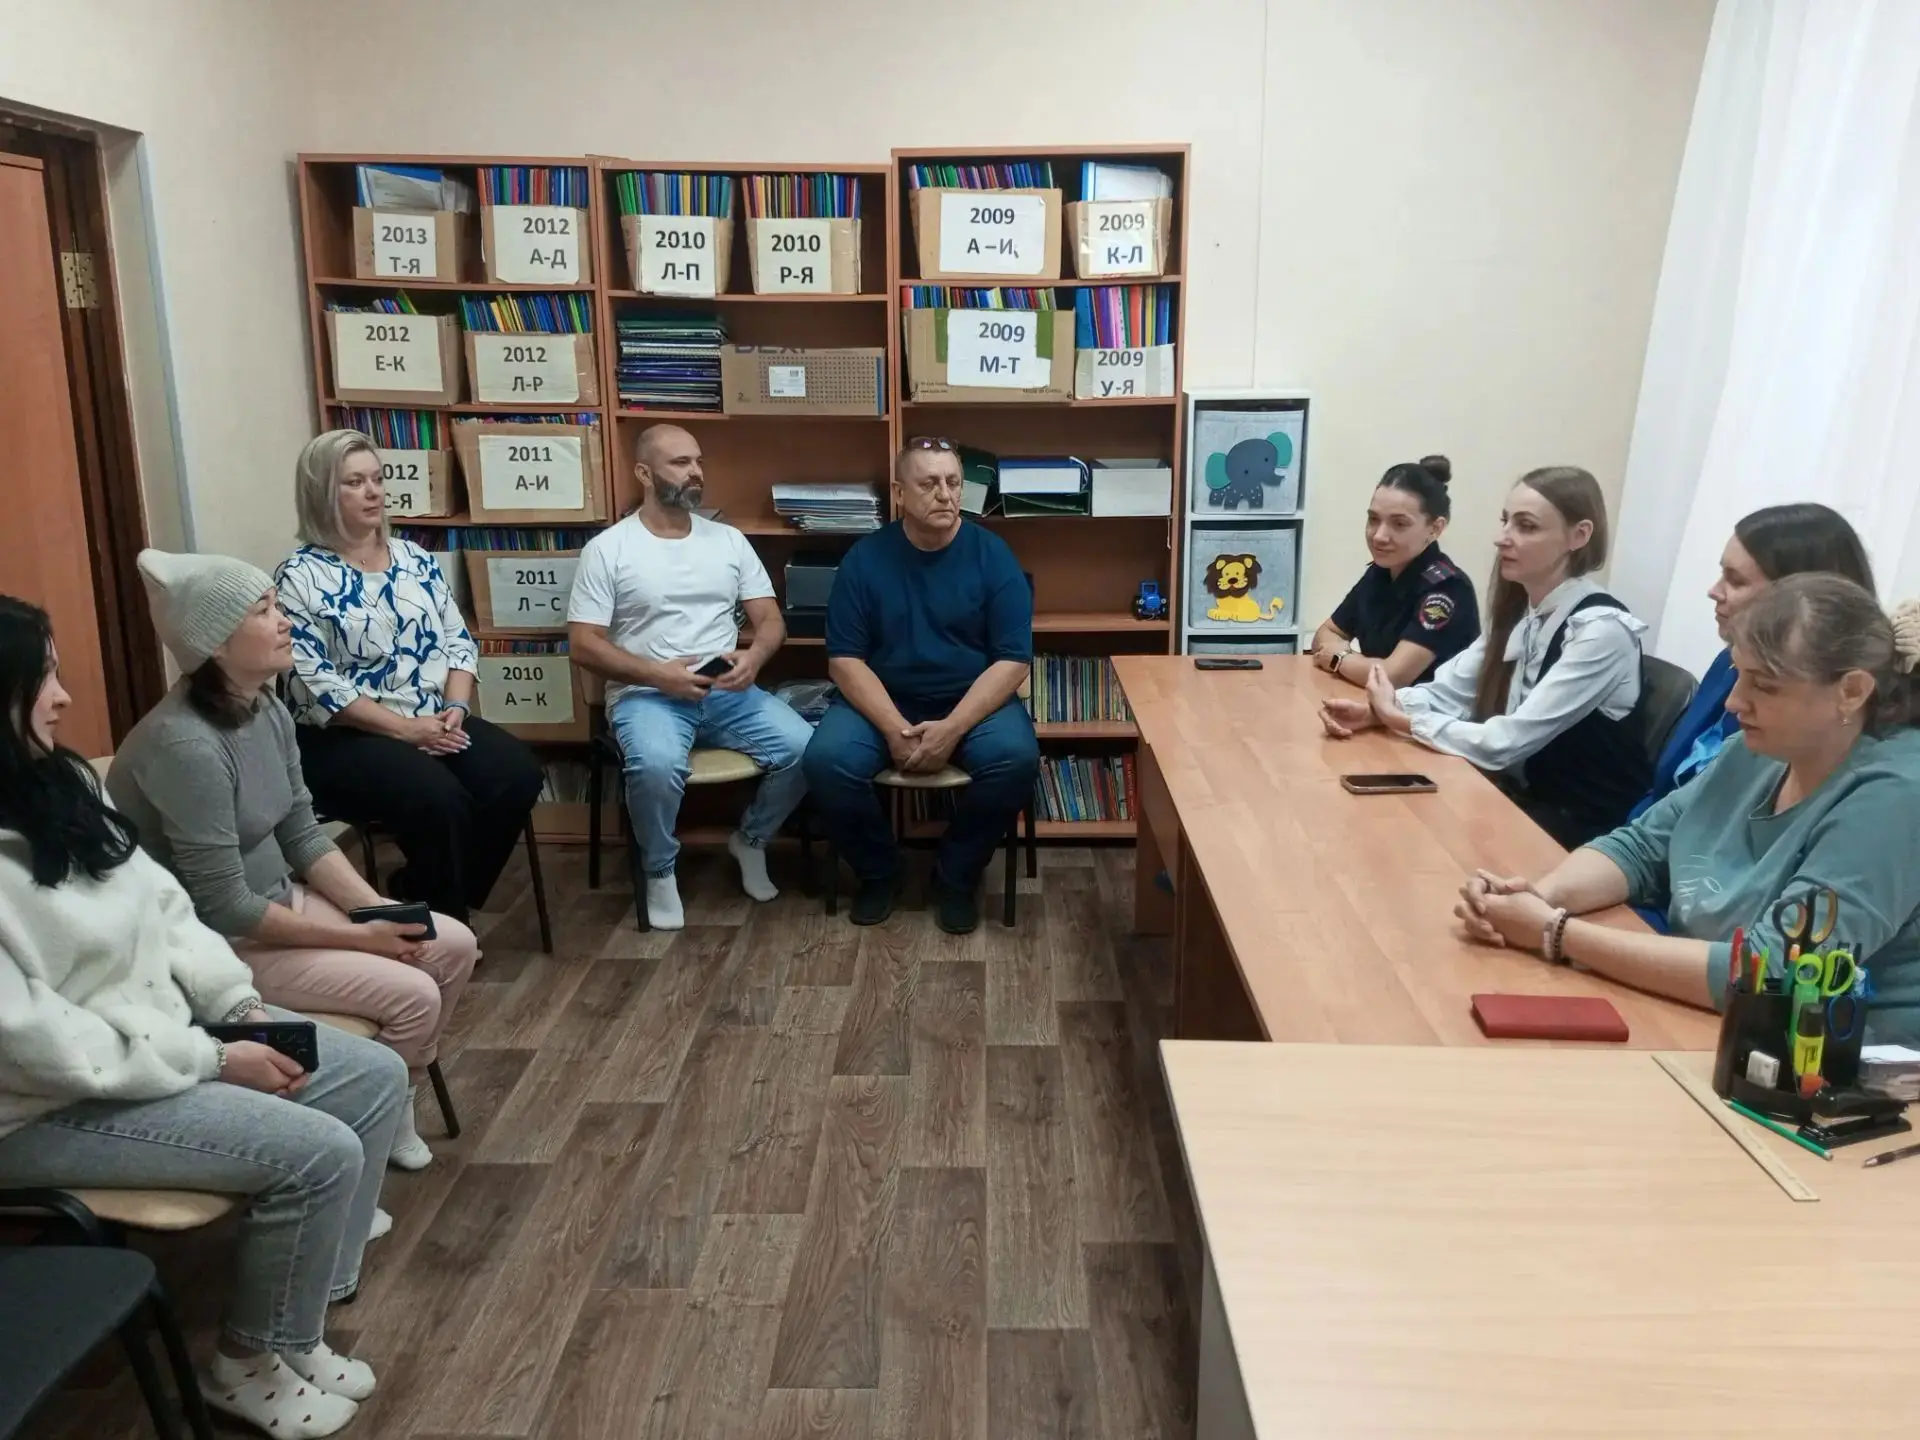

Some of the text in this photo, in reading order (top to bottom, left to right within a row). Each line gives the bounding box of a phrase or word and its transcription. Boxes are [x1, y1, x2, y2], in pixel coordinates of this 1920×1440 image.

[970, 207, 1015, 225] 2009
[1099, 213, 1145, 232] 2009
[523, 216, 570, 235] 2012
[382, 225, 428, 245] 2013
[655, 230, 706, 250] 2010
[771, 234, 821, 253] 2010
[529, 248, 567, 270] А-Д
[1107, 245, 1143, 265] К-Л
[388, 256, 421, 275] Т-Я
[661, 262, 700, 281] Л-П
[780, 266, 814, 284] Р-Я
[365, 324, 411, 343] 2012
[978, 321, 1025, 343] 2009
[375, 355, 406, 372] Е-К
[503, 346, 548, 363] 2012
[1097, 350, 1144, 367] 2009
[979, 355, 1021, 374] М-Т
[511, 375, 544, 392] Л-Р
[1101, 380, 1135, 397] У-Я
[508, 446, 553, 462] 2011
[382, 463, 420, 481] 012
[515, 474, 549, 491] А-И
[515, 570, 558, 585] 2011
[502, 666, 544, 681] 2010
